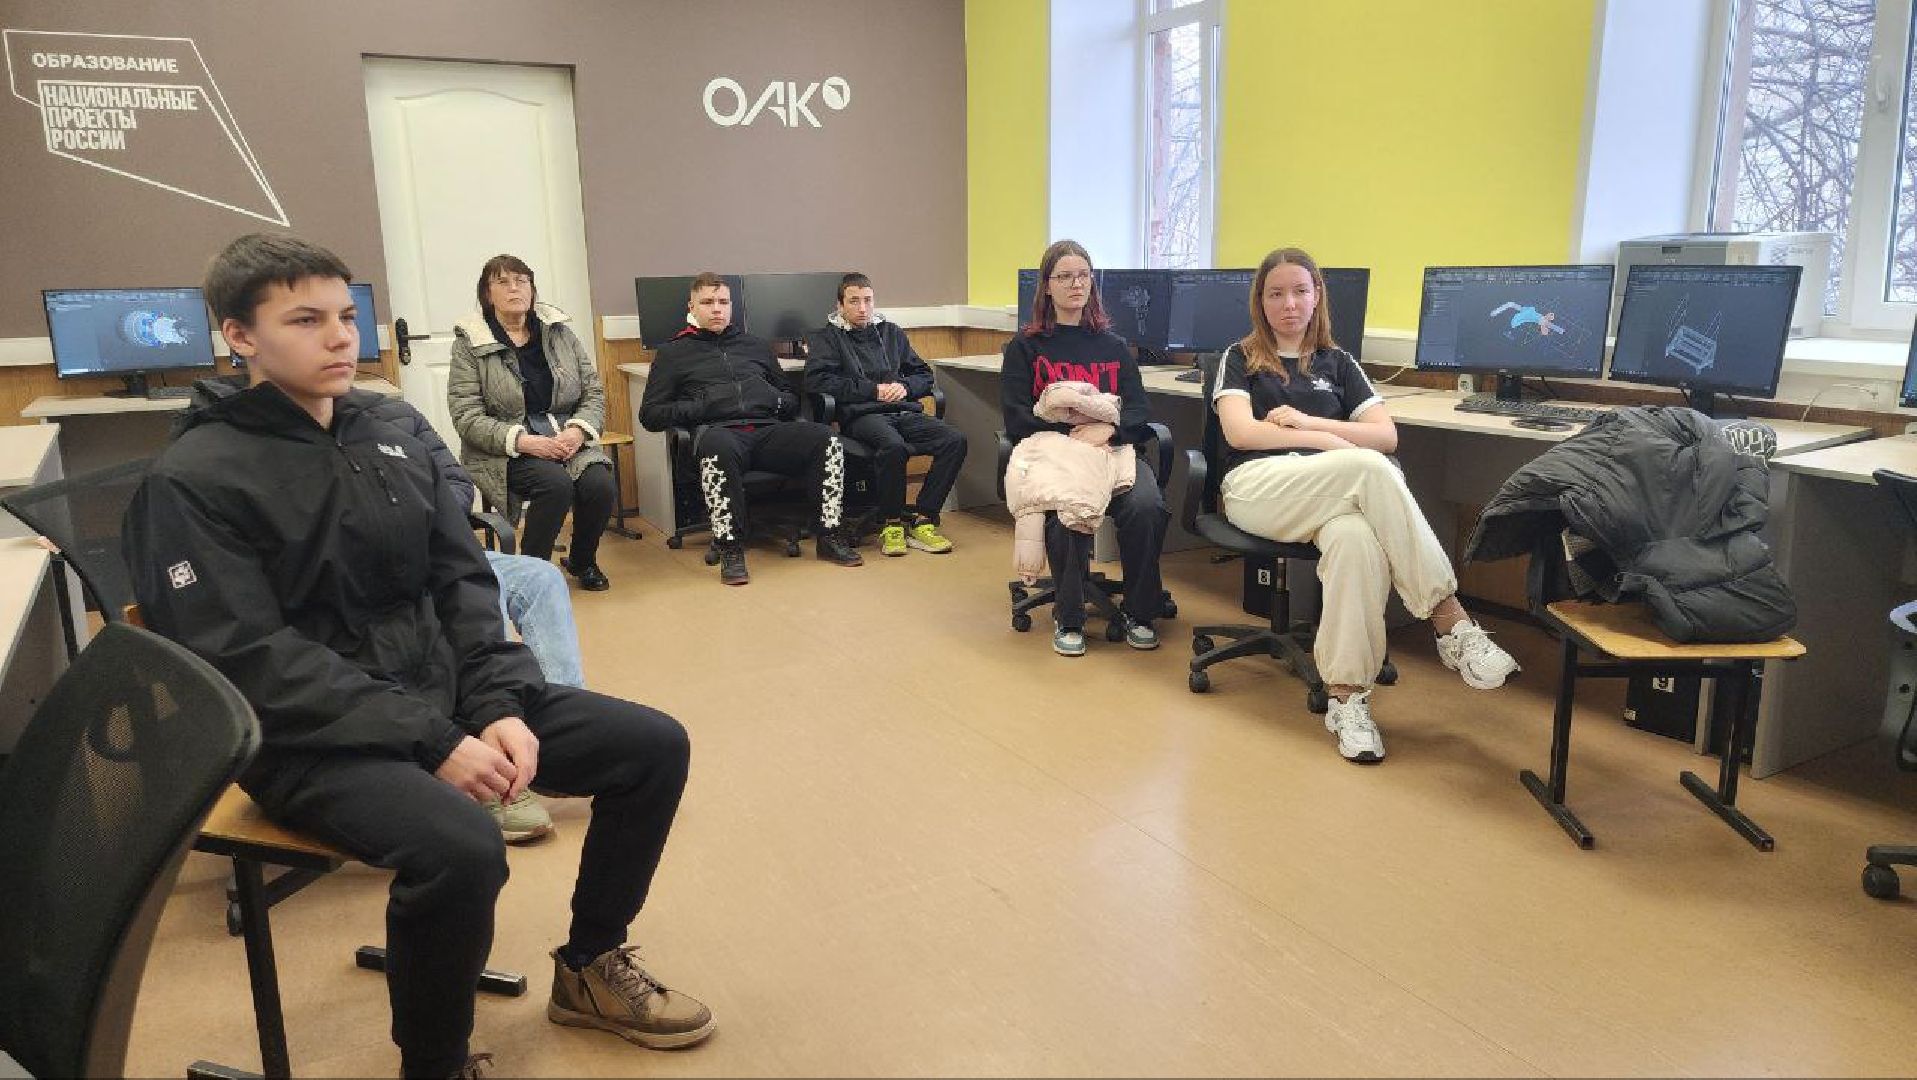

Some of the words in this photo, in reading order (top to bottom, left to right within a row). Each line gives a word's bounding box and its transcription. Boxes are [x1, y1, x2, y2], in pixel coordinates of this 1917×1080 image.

[32, 53, 179, 73] ОБРАЗОВАНИЕ
[43, 85, 198, 110] НАЦИОНАЛЬНЫЕ
[49, 108, 137, 129] ПРОЕКТЫ
[52, 129, 126, 150] РОССИИ
